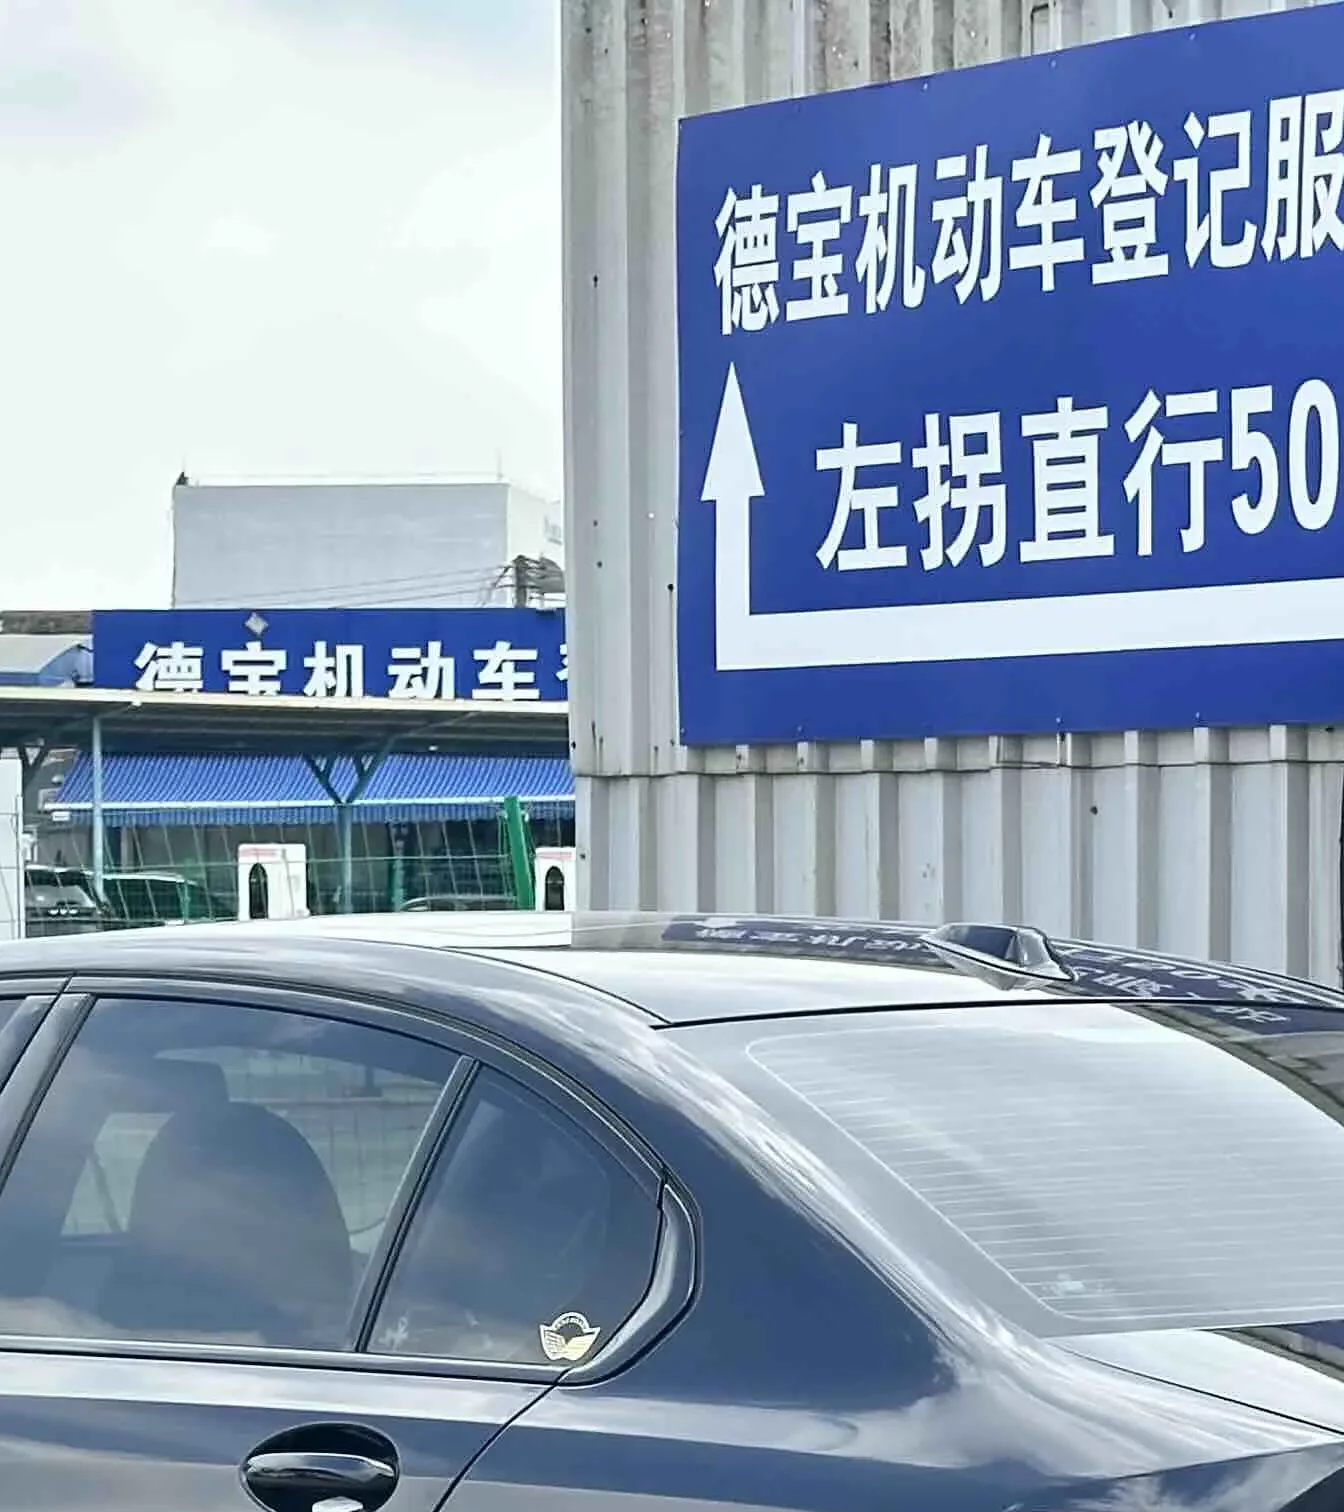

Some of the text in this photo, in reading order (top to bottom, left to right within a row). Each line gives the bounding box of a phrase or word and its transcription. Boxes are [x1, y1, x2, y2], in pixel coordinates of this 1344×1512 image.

[134, 641, 567, 700] 德宝机动车
